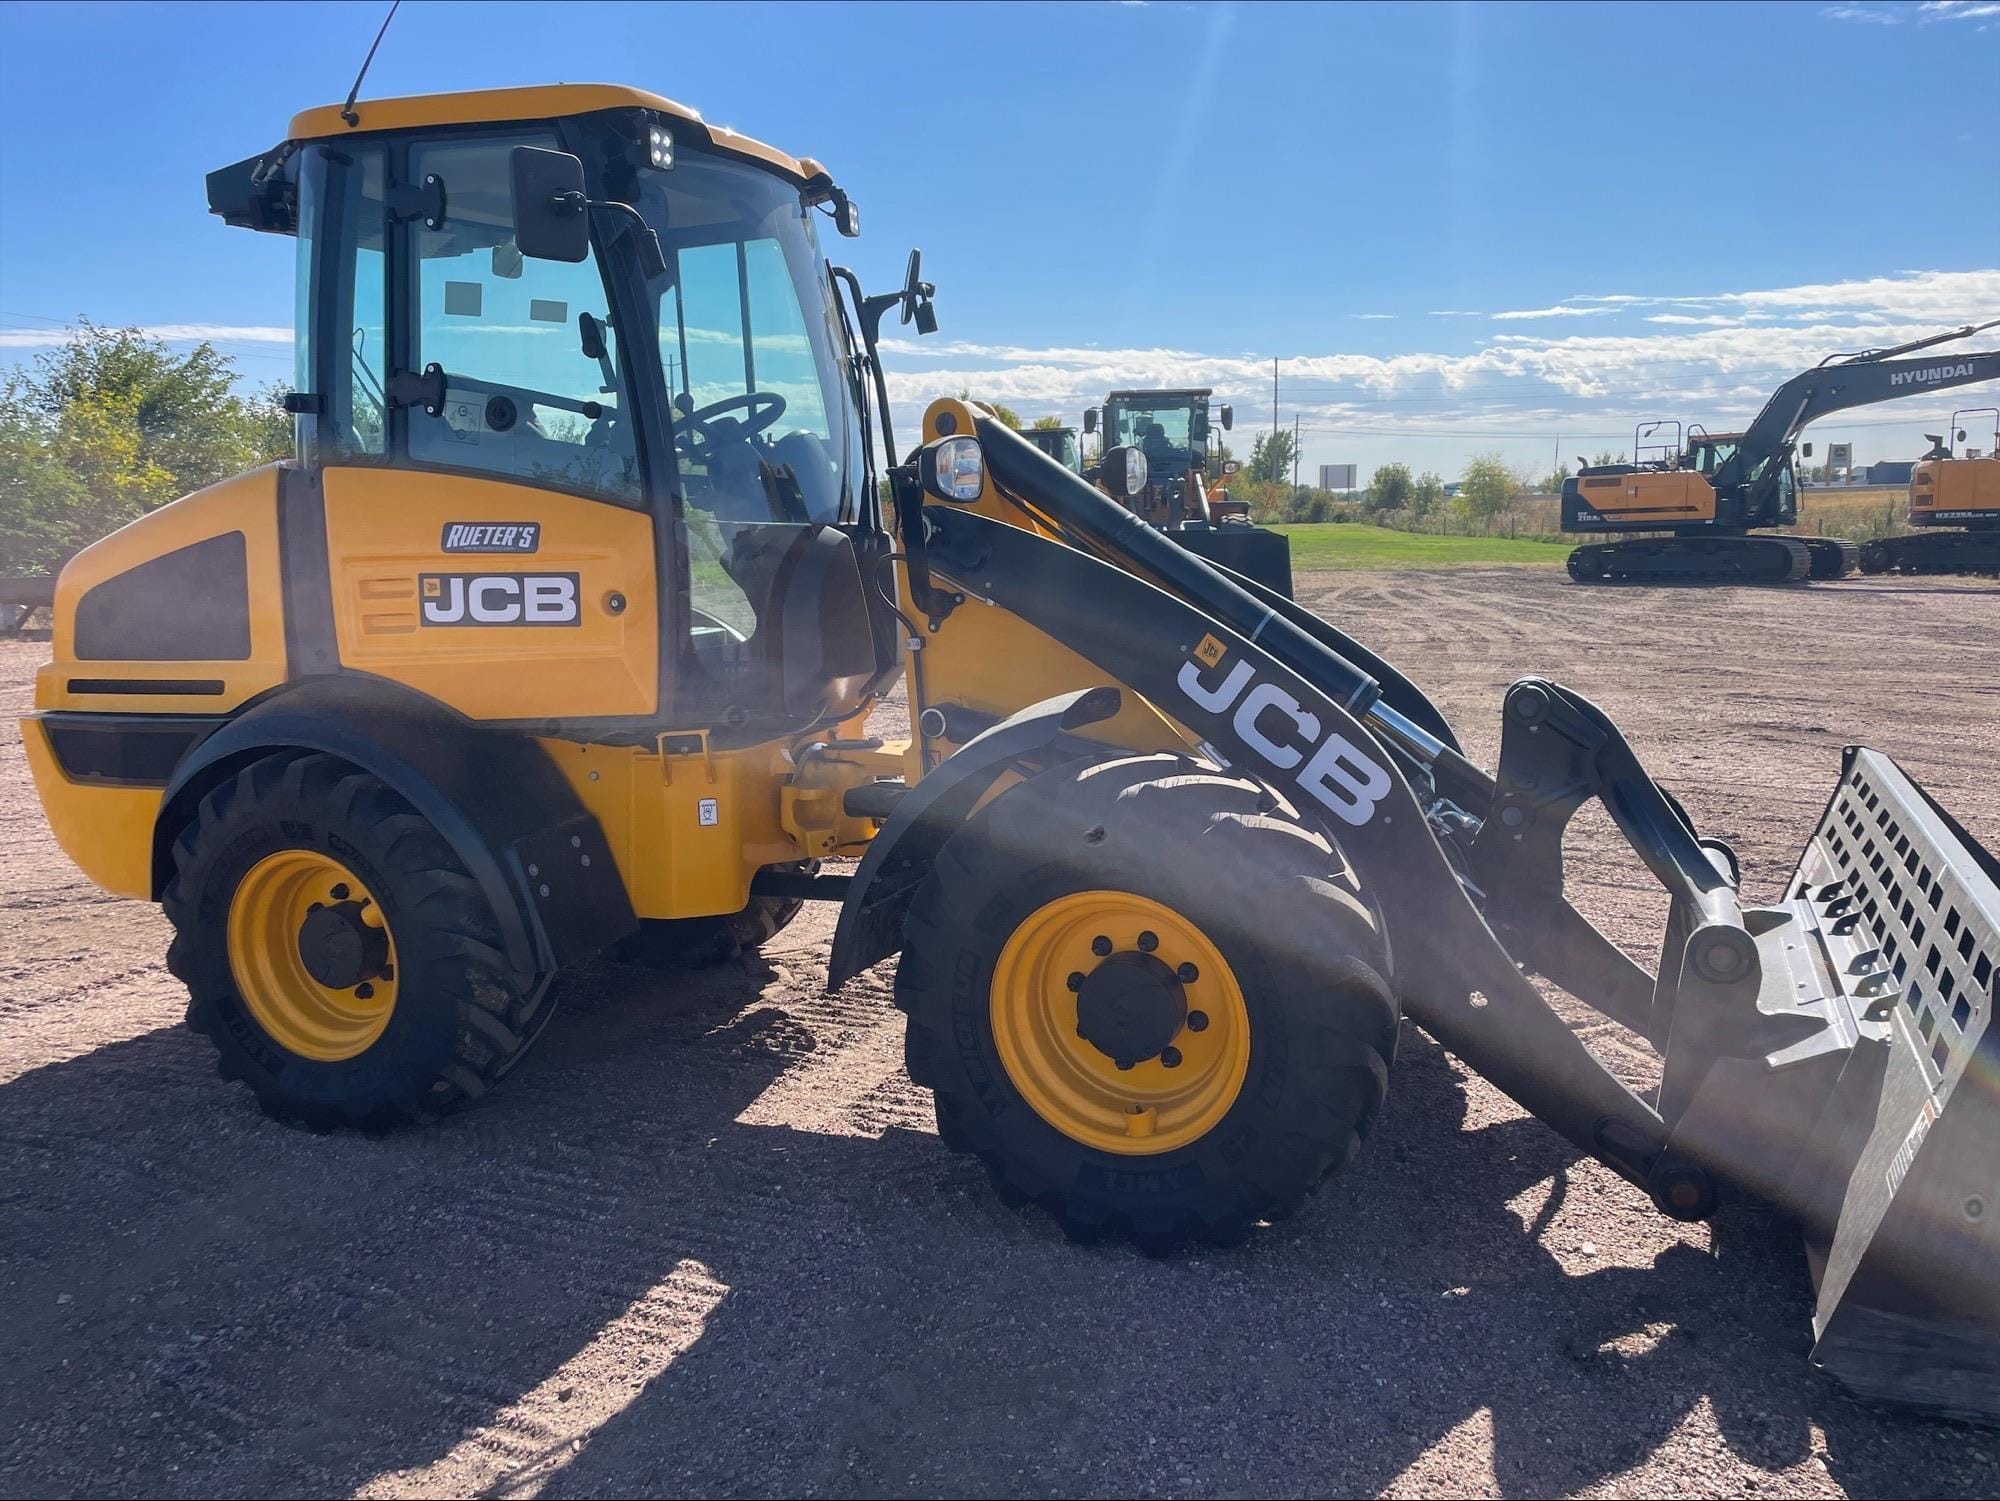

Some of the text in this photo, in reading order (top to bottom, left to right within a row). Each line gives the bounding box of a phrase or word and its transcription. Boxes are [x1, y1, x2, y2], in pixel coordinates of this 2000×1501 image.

[1891, 363, 1974, 386] HYUNDAI
[446, 524, 536, 548] RUETER'S
[424, 577, 577, 622] JCB
[1177, 658, 1392, 826] JCB
